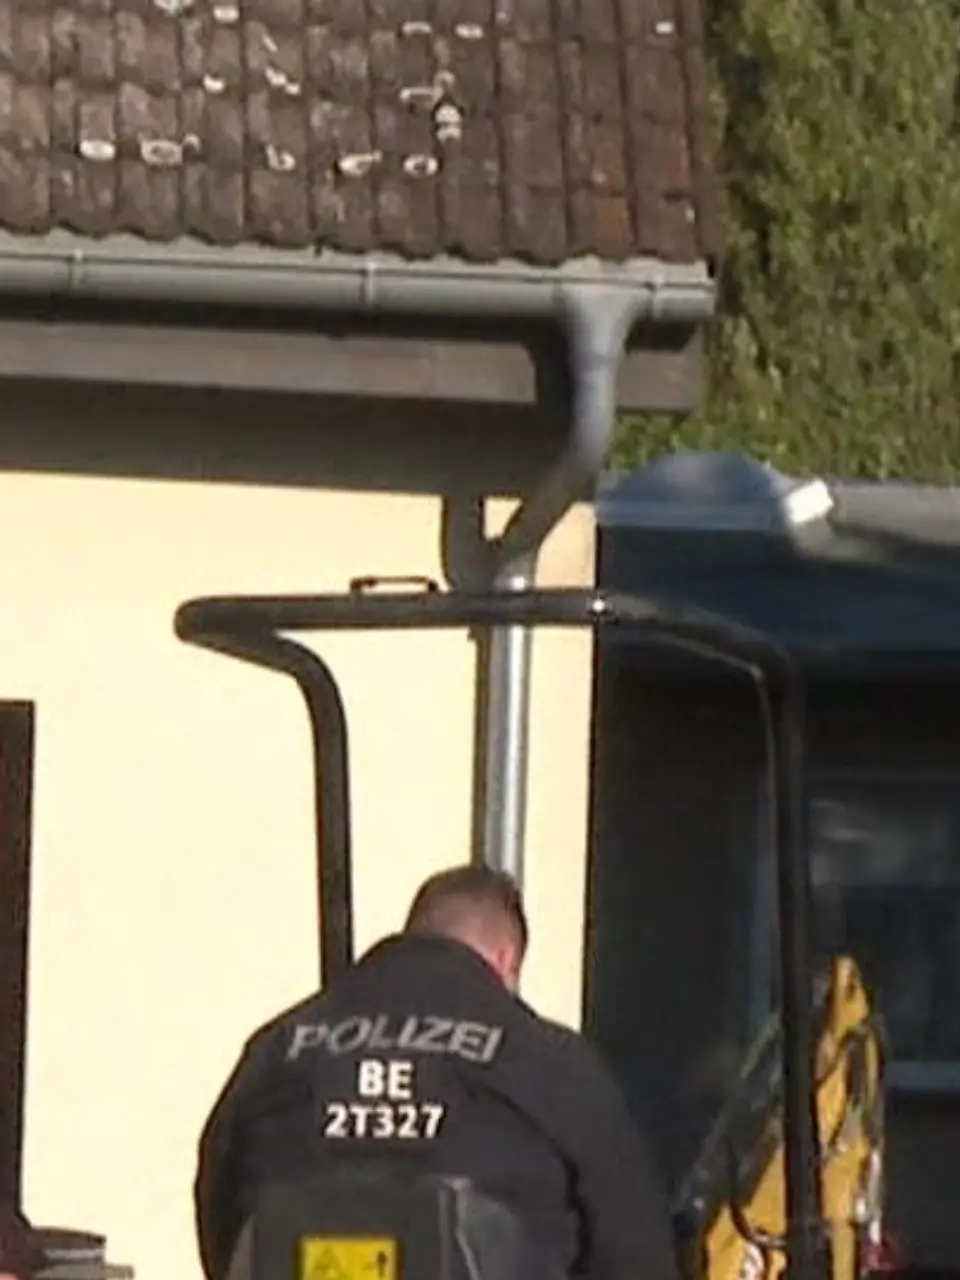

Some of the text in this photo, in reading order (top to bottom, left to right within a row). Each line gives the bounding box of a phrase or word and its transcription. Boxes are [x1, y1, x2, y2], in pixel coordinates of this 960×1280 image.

[285, 1015, 502, 1062] POLIZEI
[358, 1060, 413, 1099] BE
[324, 1105, 444, 1138] 2T327
